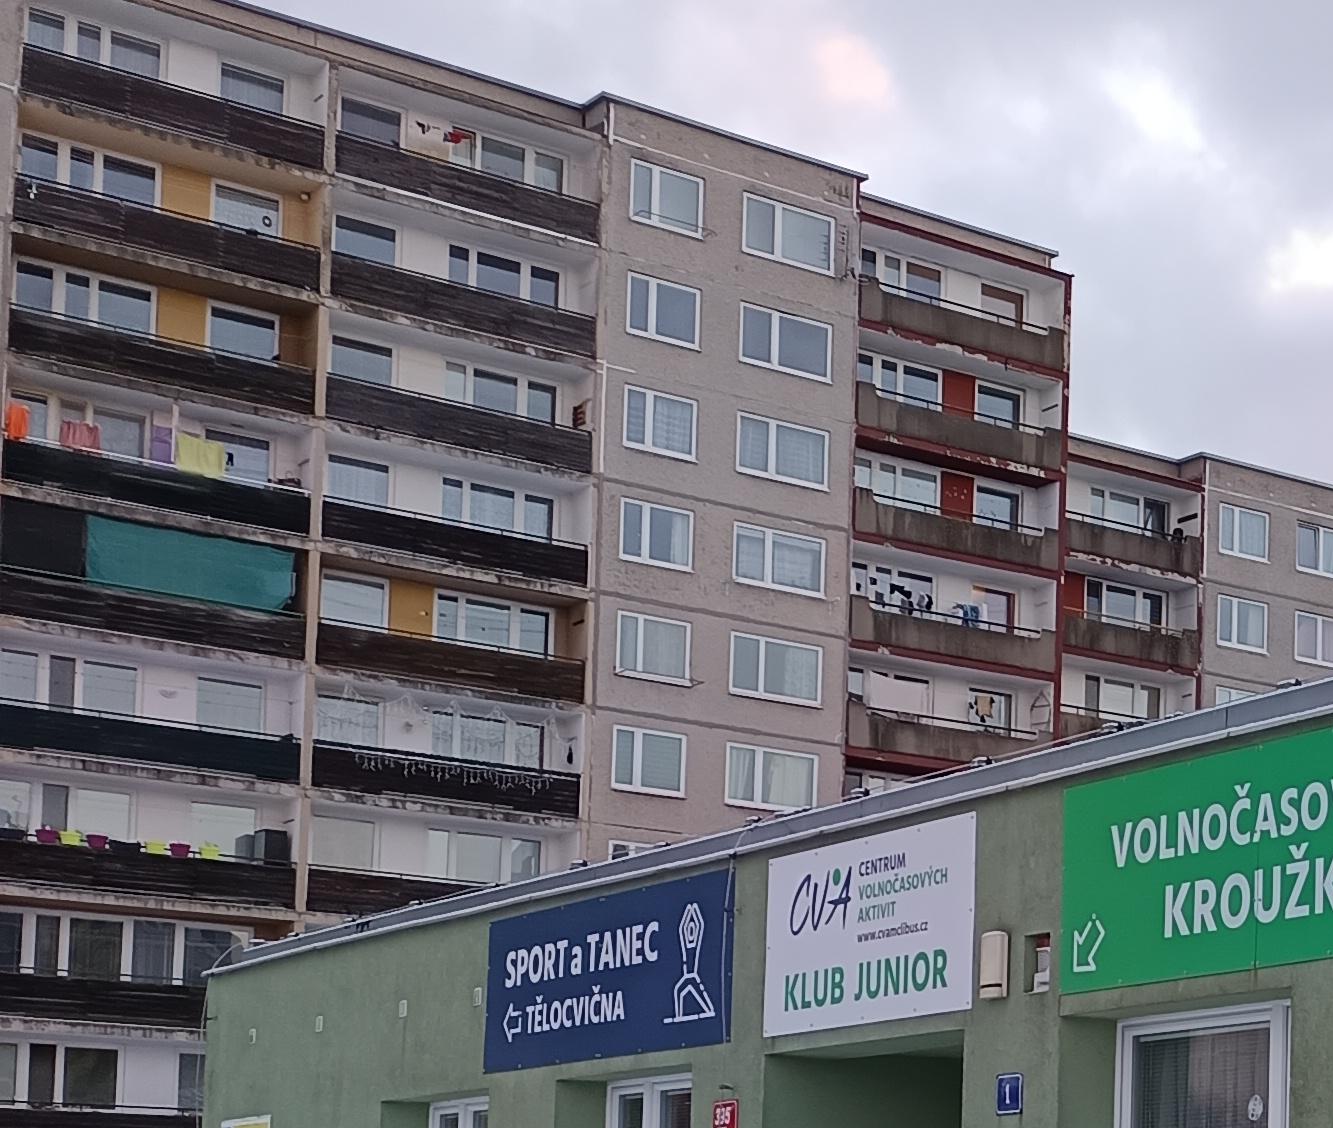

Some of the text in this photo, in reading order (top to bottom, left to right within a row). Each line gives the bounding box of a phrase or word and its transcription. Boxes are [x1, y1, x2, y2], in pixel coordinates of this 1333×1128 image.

[858, 852, 907, 877] CENTRUM
[858, 865, 949, 900] VOLNOČASOVÝCH
[857, 901, 897, 923] AKTIVIT
[504, 921, 659, 989] SPORT a TANEC
[784, 949, 948, 1012] KLUB JUNIOR
[525, 984, 625, 1034] TĚLOCVIČNA
[1004, 1083, 1011, 1104] 1
